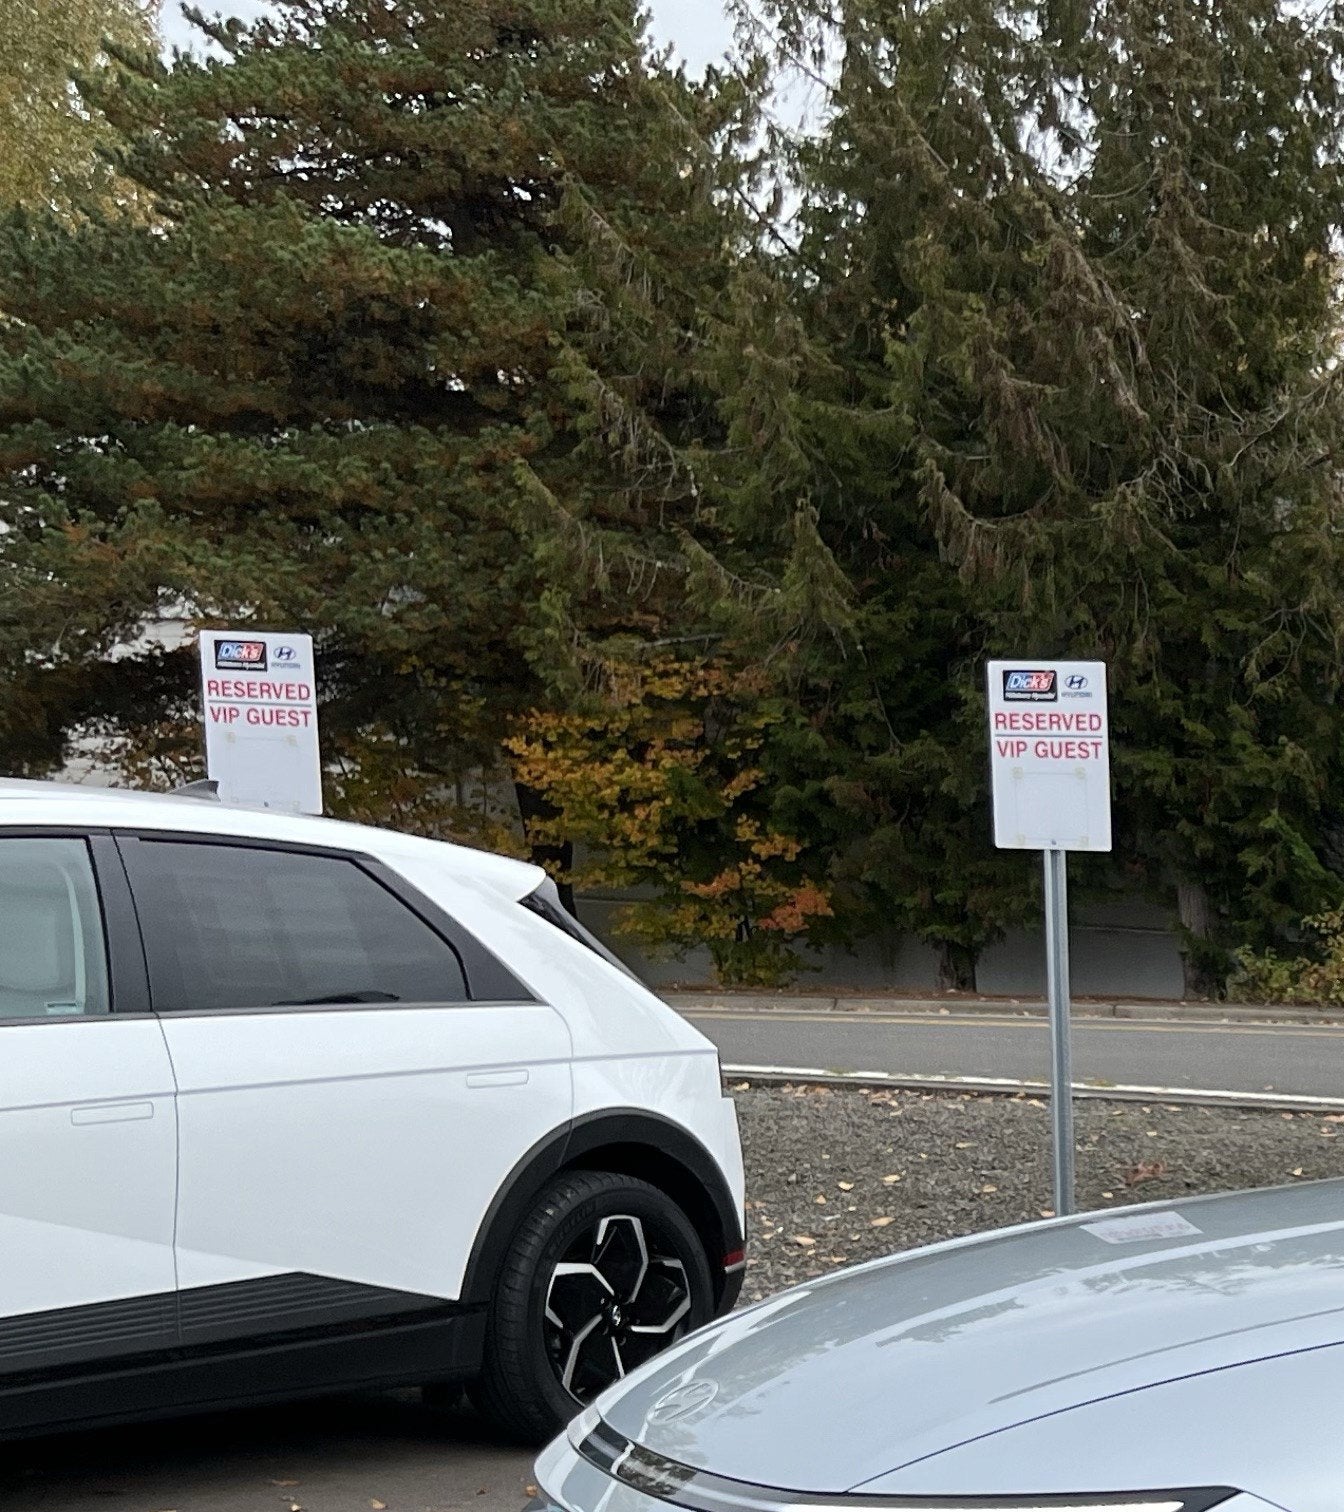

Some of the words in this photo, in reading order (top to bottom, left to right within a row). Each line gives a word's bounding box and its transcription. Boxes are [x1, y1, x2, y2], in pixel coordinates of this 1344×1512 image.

[207, 679, 311, 700] RESERVED
[209, 706, 240, 724] VIP
[246, 708, 312, 727] GUEST
[994, 713, 1102, 731] RESERVED
[996, 741, 1028, 758] VIP
[1035, 741, 1103, 760] GUEST
